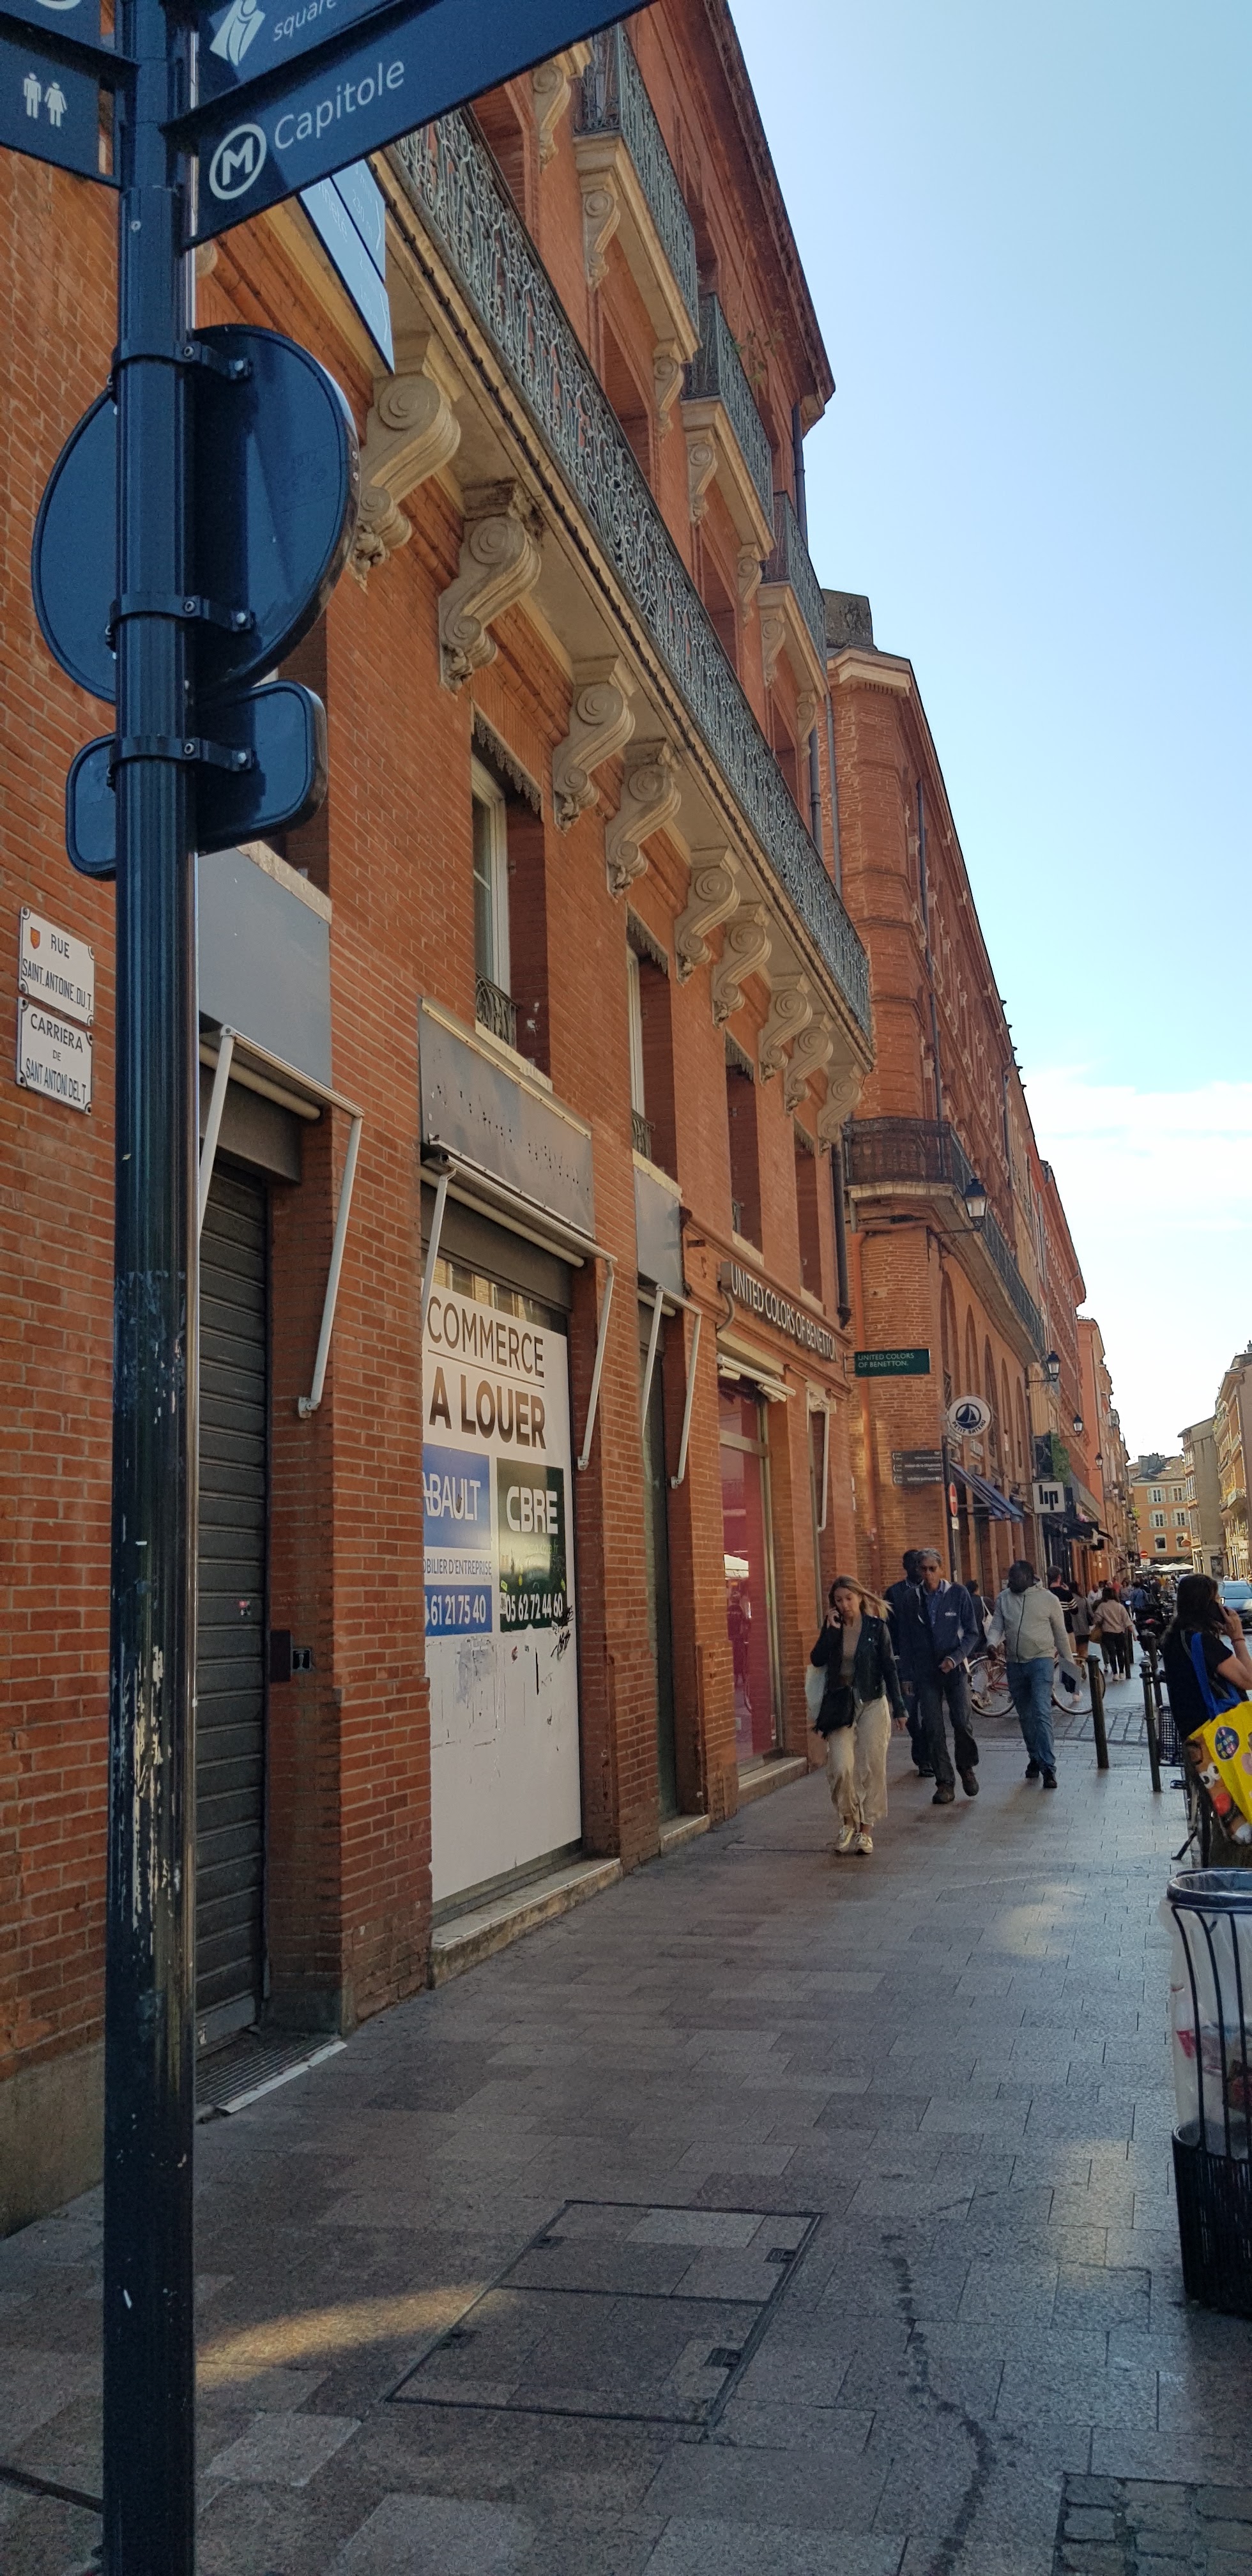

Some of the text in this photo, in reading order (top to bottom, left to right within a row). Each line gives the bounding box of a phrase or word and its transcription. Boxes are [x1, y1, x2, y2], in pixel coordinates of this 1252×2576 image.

[275, 61, 404, 150] Capitole
[50, 933, 70, 959] RUE
[52, 1049, 61, 1061] DE
[26, 1057, 43, 1085] SANT
[731, 1261, 839, 1362] UNITED COLORS OF BENETTON
[427, 1296, 545, 1379] COMMERCE
[429, 1366, 547, 1450] A LOUER
[952, 1419, 987, 1434] PETIT BATEAU
[506, 1485, 558, 1534] CBRE
[448, 1560, 492, 1575] D'ENTREPRISE
[431, 1594, 486, 1626] 61 21 75 40
[506, 1592, 563, 1622] 05 62 72 44 60
